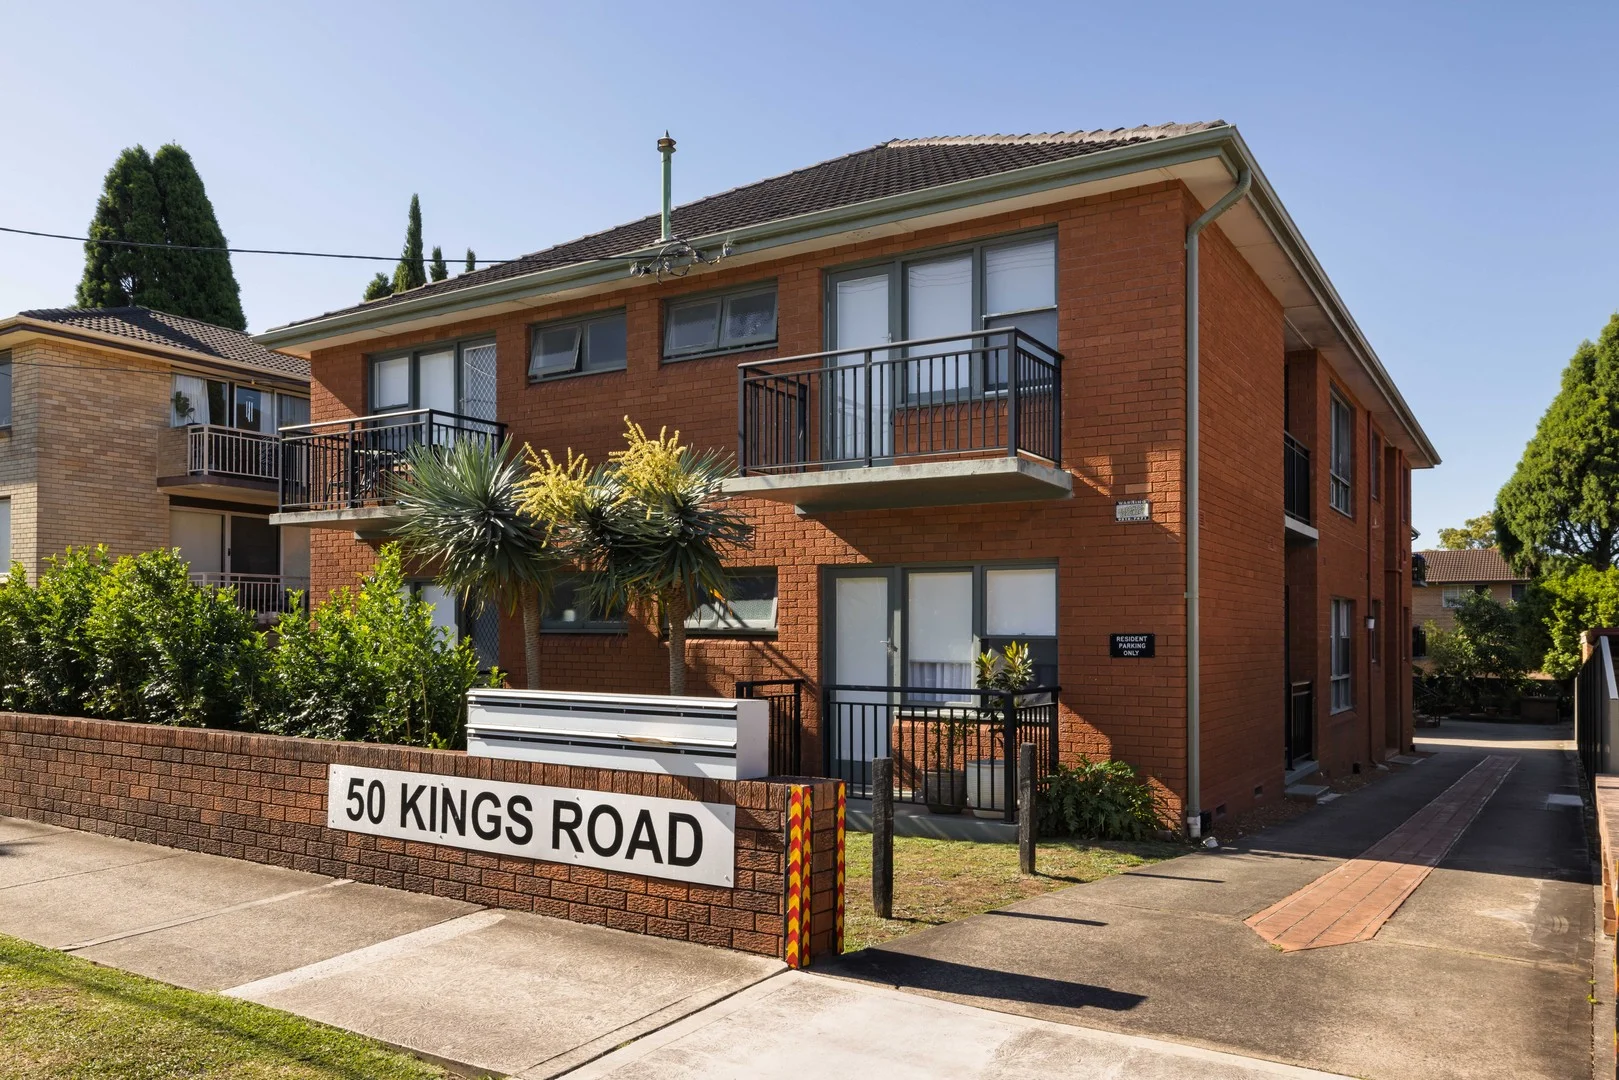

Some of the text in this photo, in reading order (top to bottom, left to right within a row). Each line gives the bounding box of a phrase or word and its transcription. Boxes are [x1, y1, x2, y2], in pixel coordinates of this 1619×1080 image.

[346, 777, 703, 867] 50 KINGS ROAD
